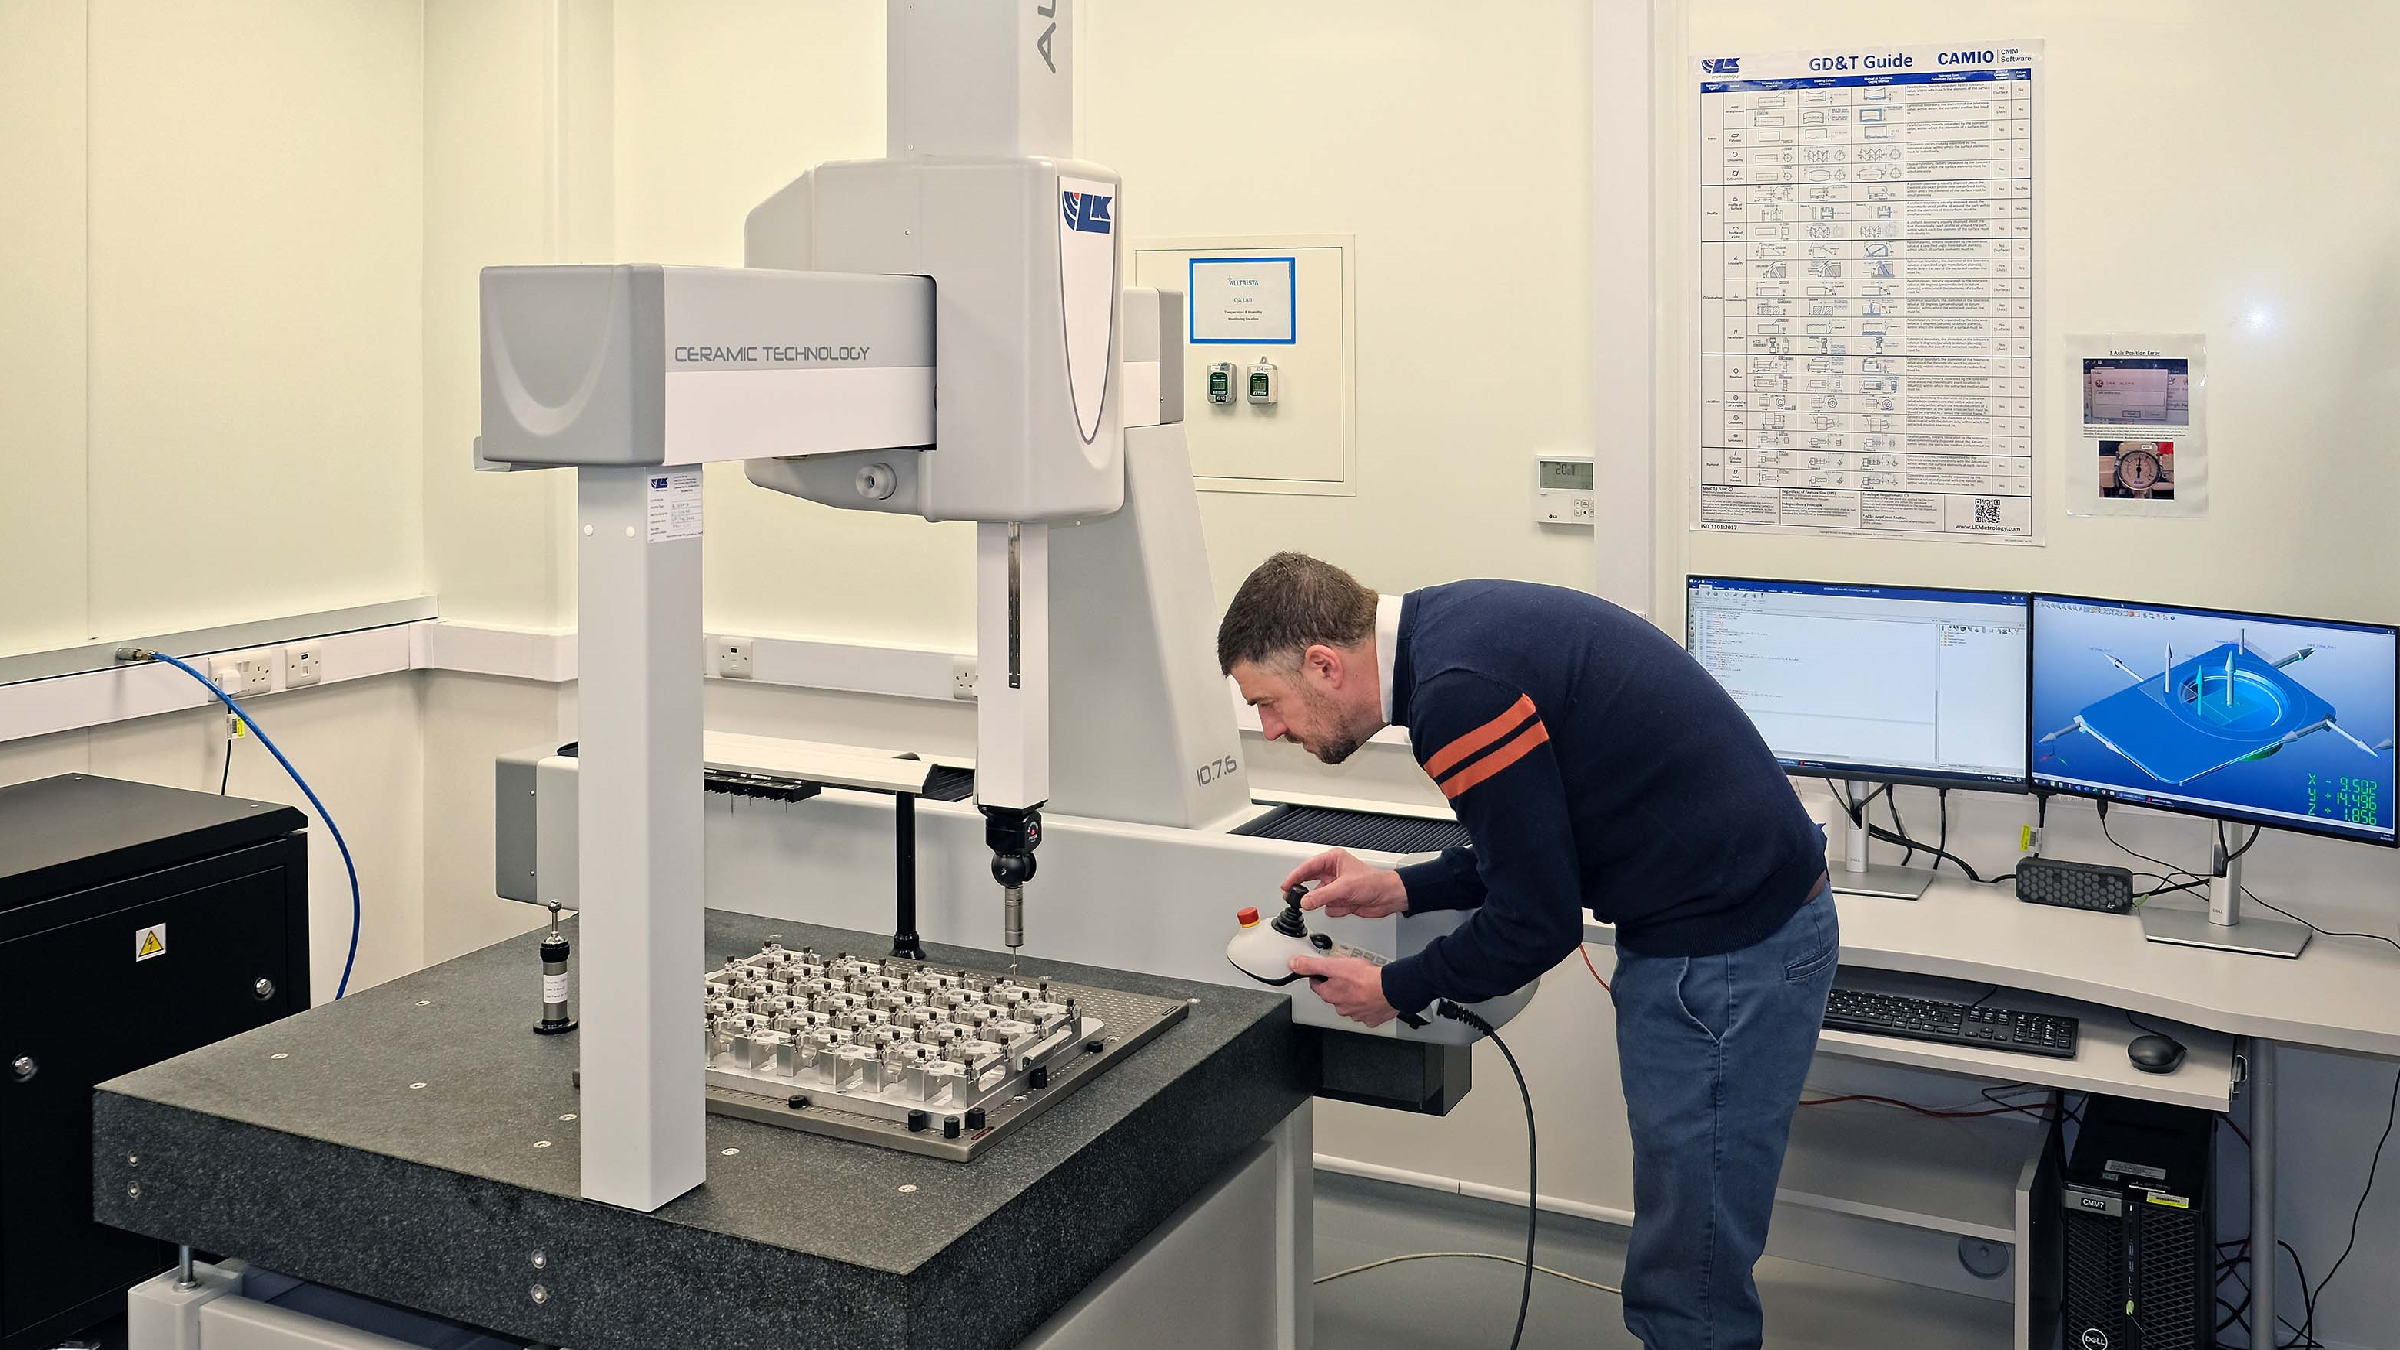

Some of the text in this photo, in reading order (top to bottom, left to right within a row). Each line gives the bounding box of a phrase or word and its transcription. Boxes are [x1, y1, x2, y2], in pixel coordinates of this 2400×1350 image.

[1808, 52, 1914, 71] GD&T Guide
[1937, 50, 1995, 66] CAMIO
[2000, 54, 2033, 64] Software
[1075, 192, 1113, 235] LK
[675, 346, 871, 362] CERAMIC TECHNOLOGY
[1196, 754, 1238, 788] 10.7.6
[2308, 772, 2317, 786] X
[2340, 776, 2378, 796] 9.502
[2308, 802, 2316, 816] Z
[2344, 807, 2377, 826] 1.856
[2085, 1335, 2106, 1346] DELL
